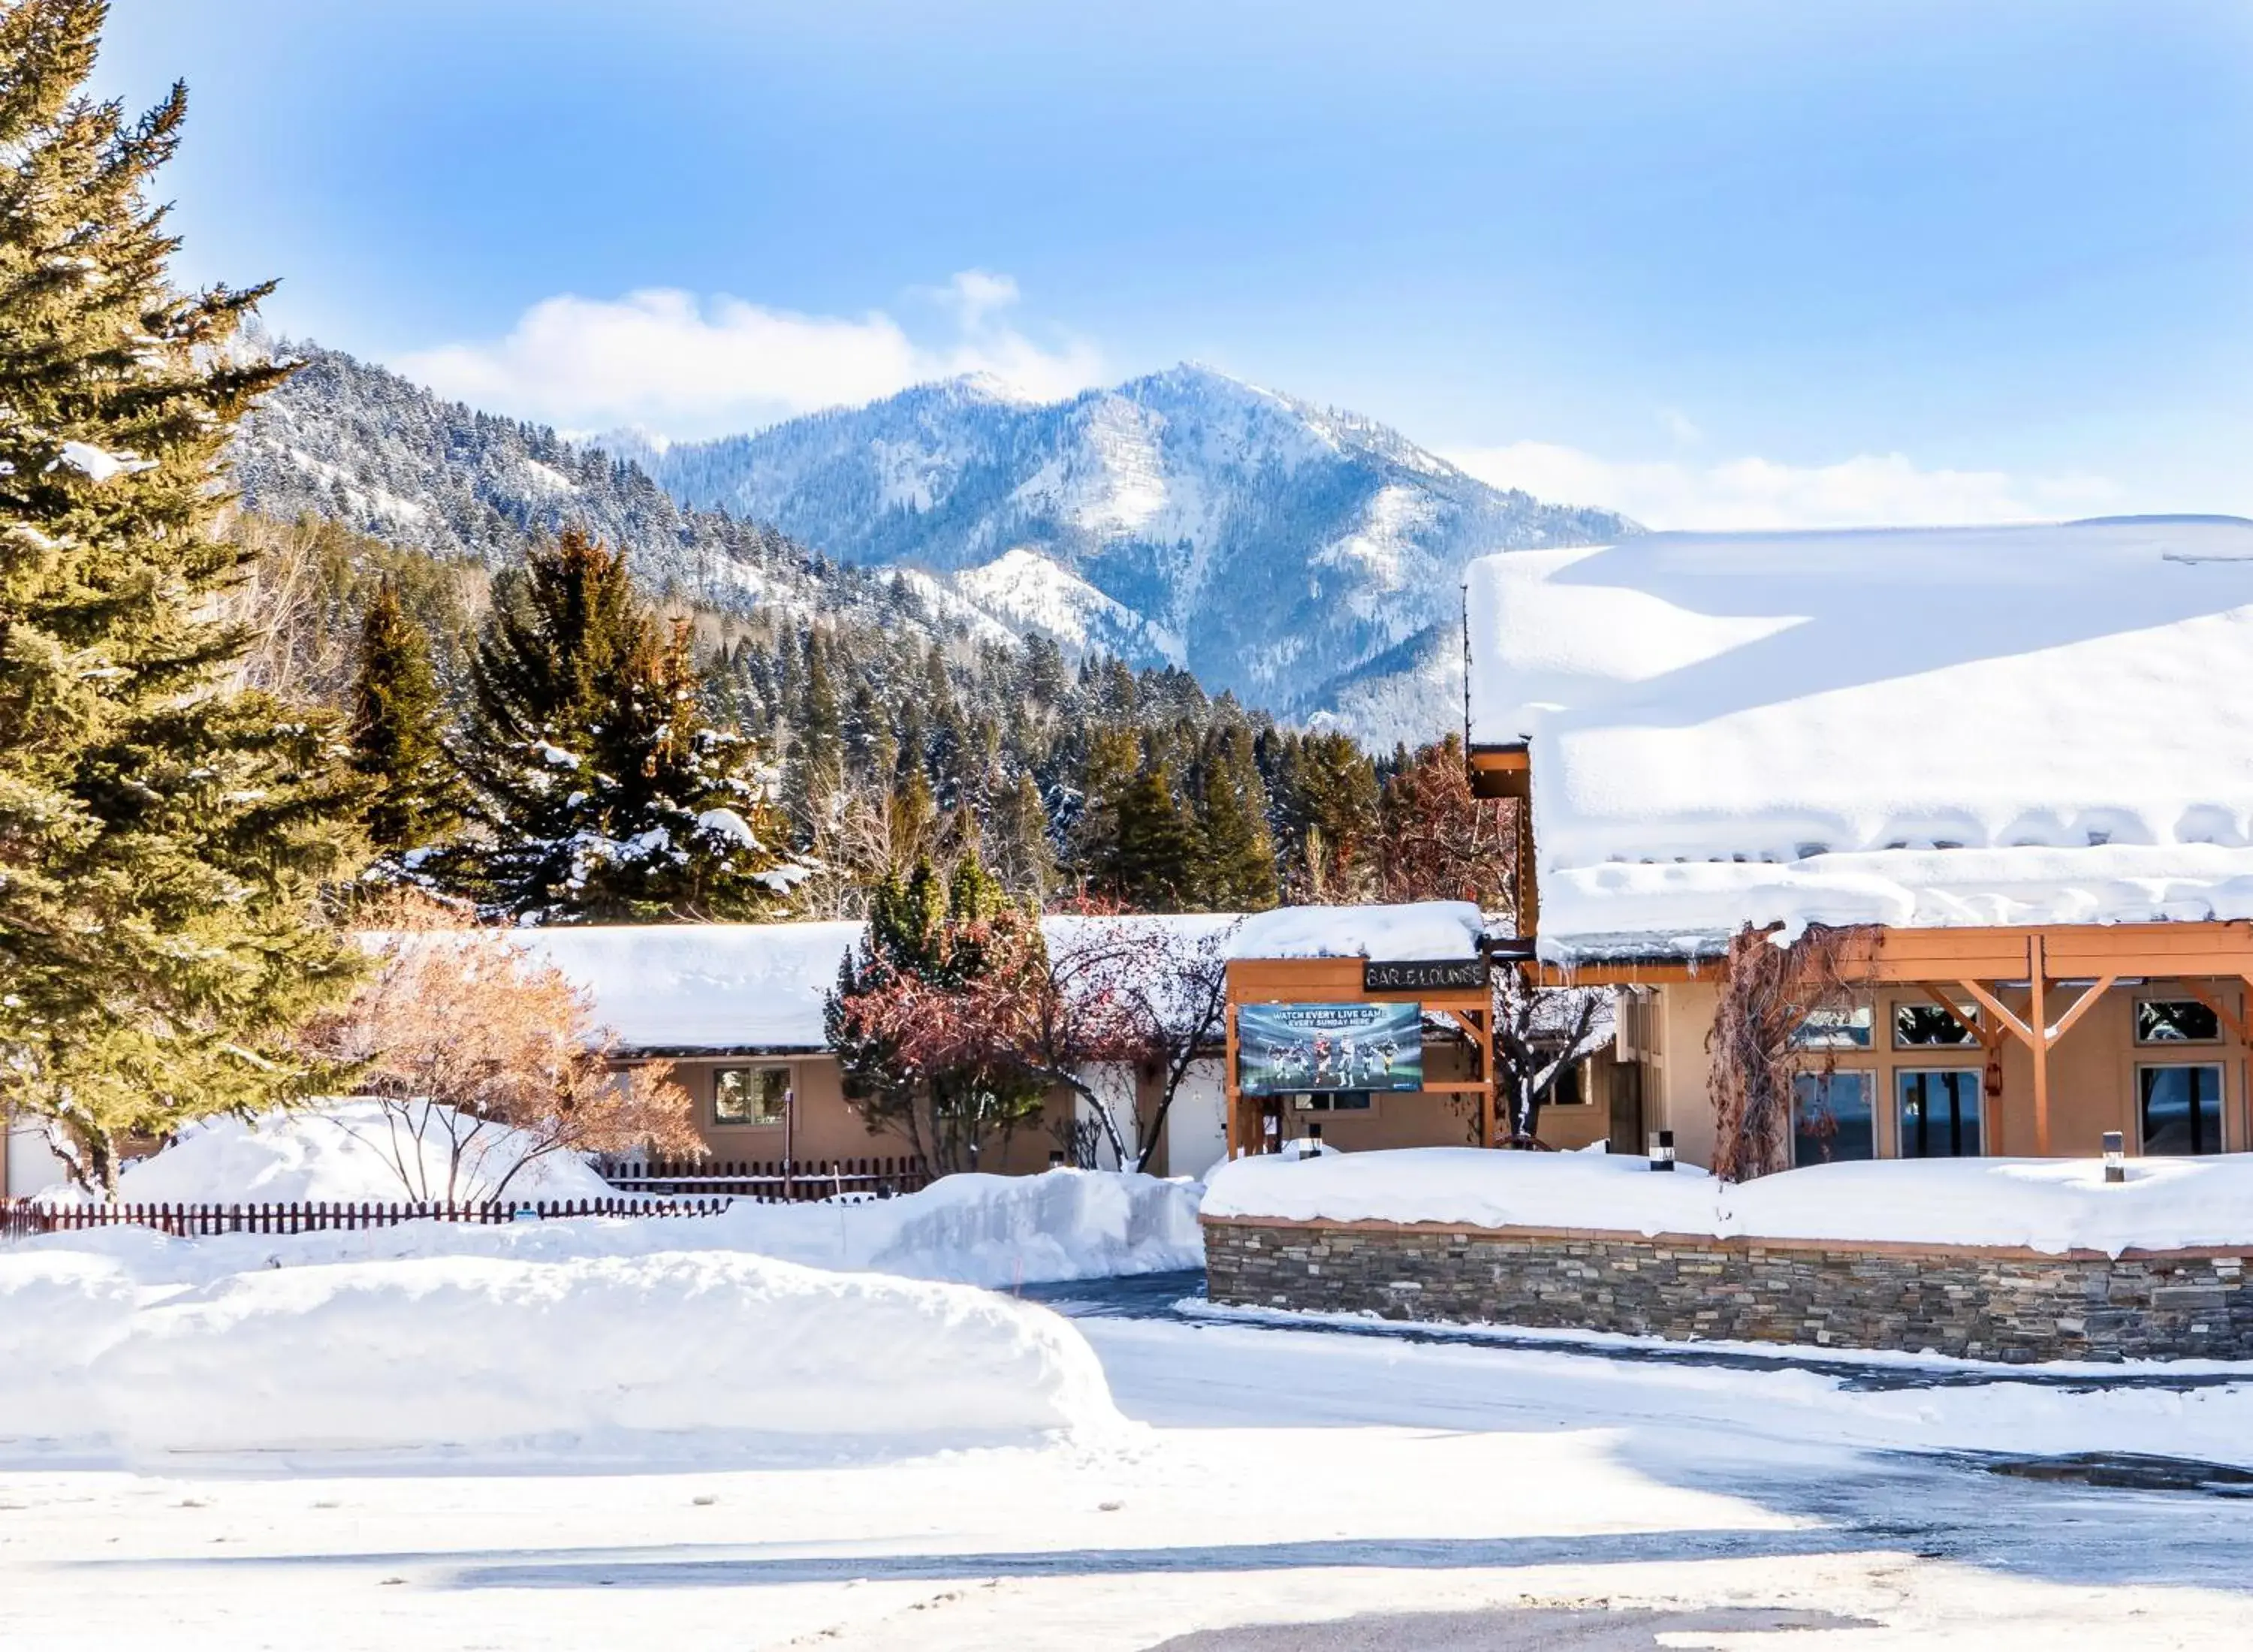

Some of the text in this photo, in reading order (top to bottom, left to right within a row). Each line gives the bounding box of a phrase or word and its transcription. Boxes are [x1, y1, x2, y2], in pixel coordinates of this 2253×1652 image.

[1367, 968, 1399, 986] BAR
[1419, 964, 1484, 986] LOUNGE
[1273, 1009, 1388, 1020] WATCH EVERY LIVE GAME
[1317, 1018, 1347, 1026] SUNDAY
